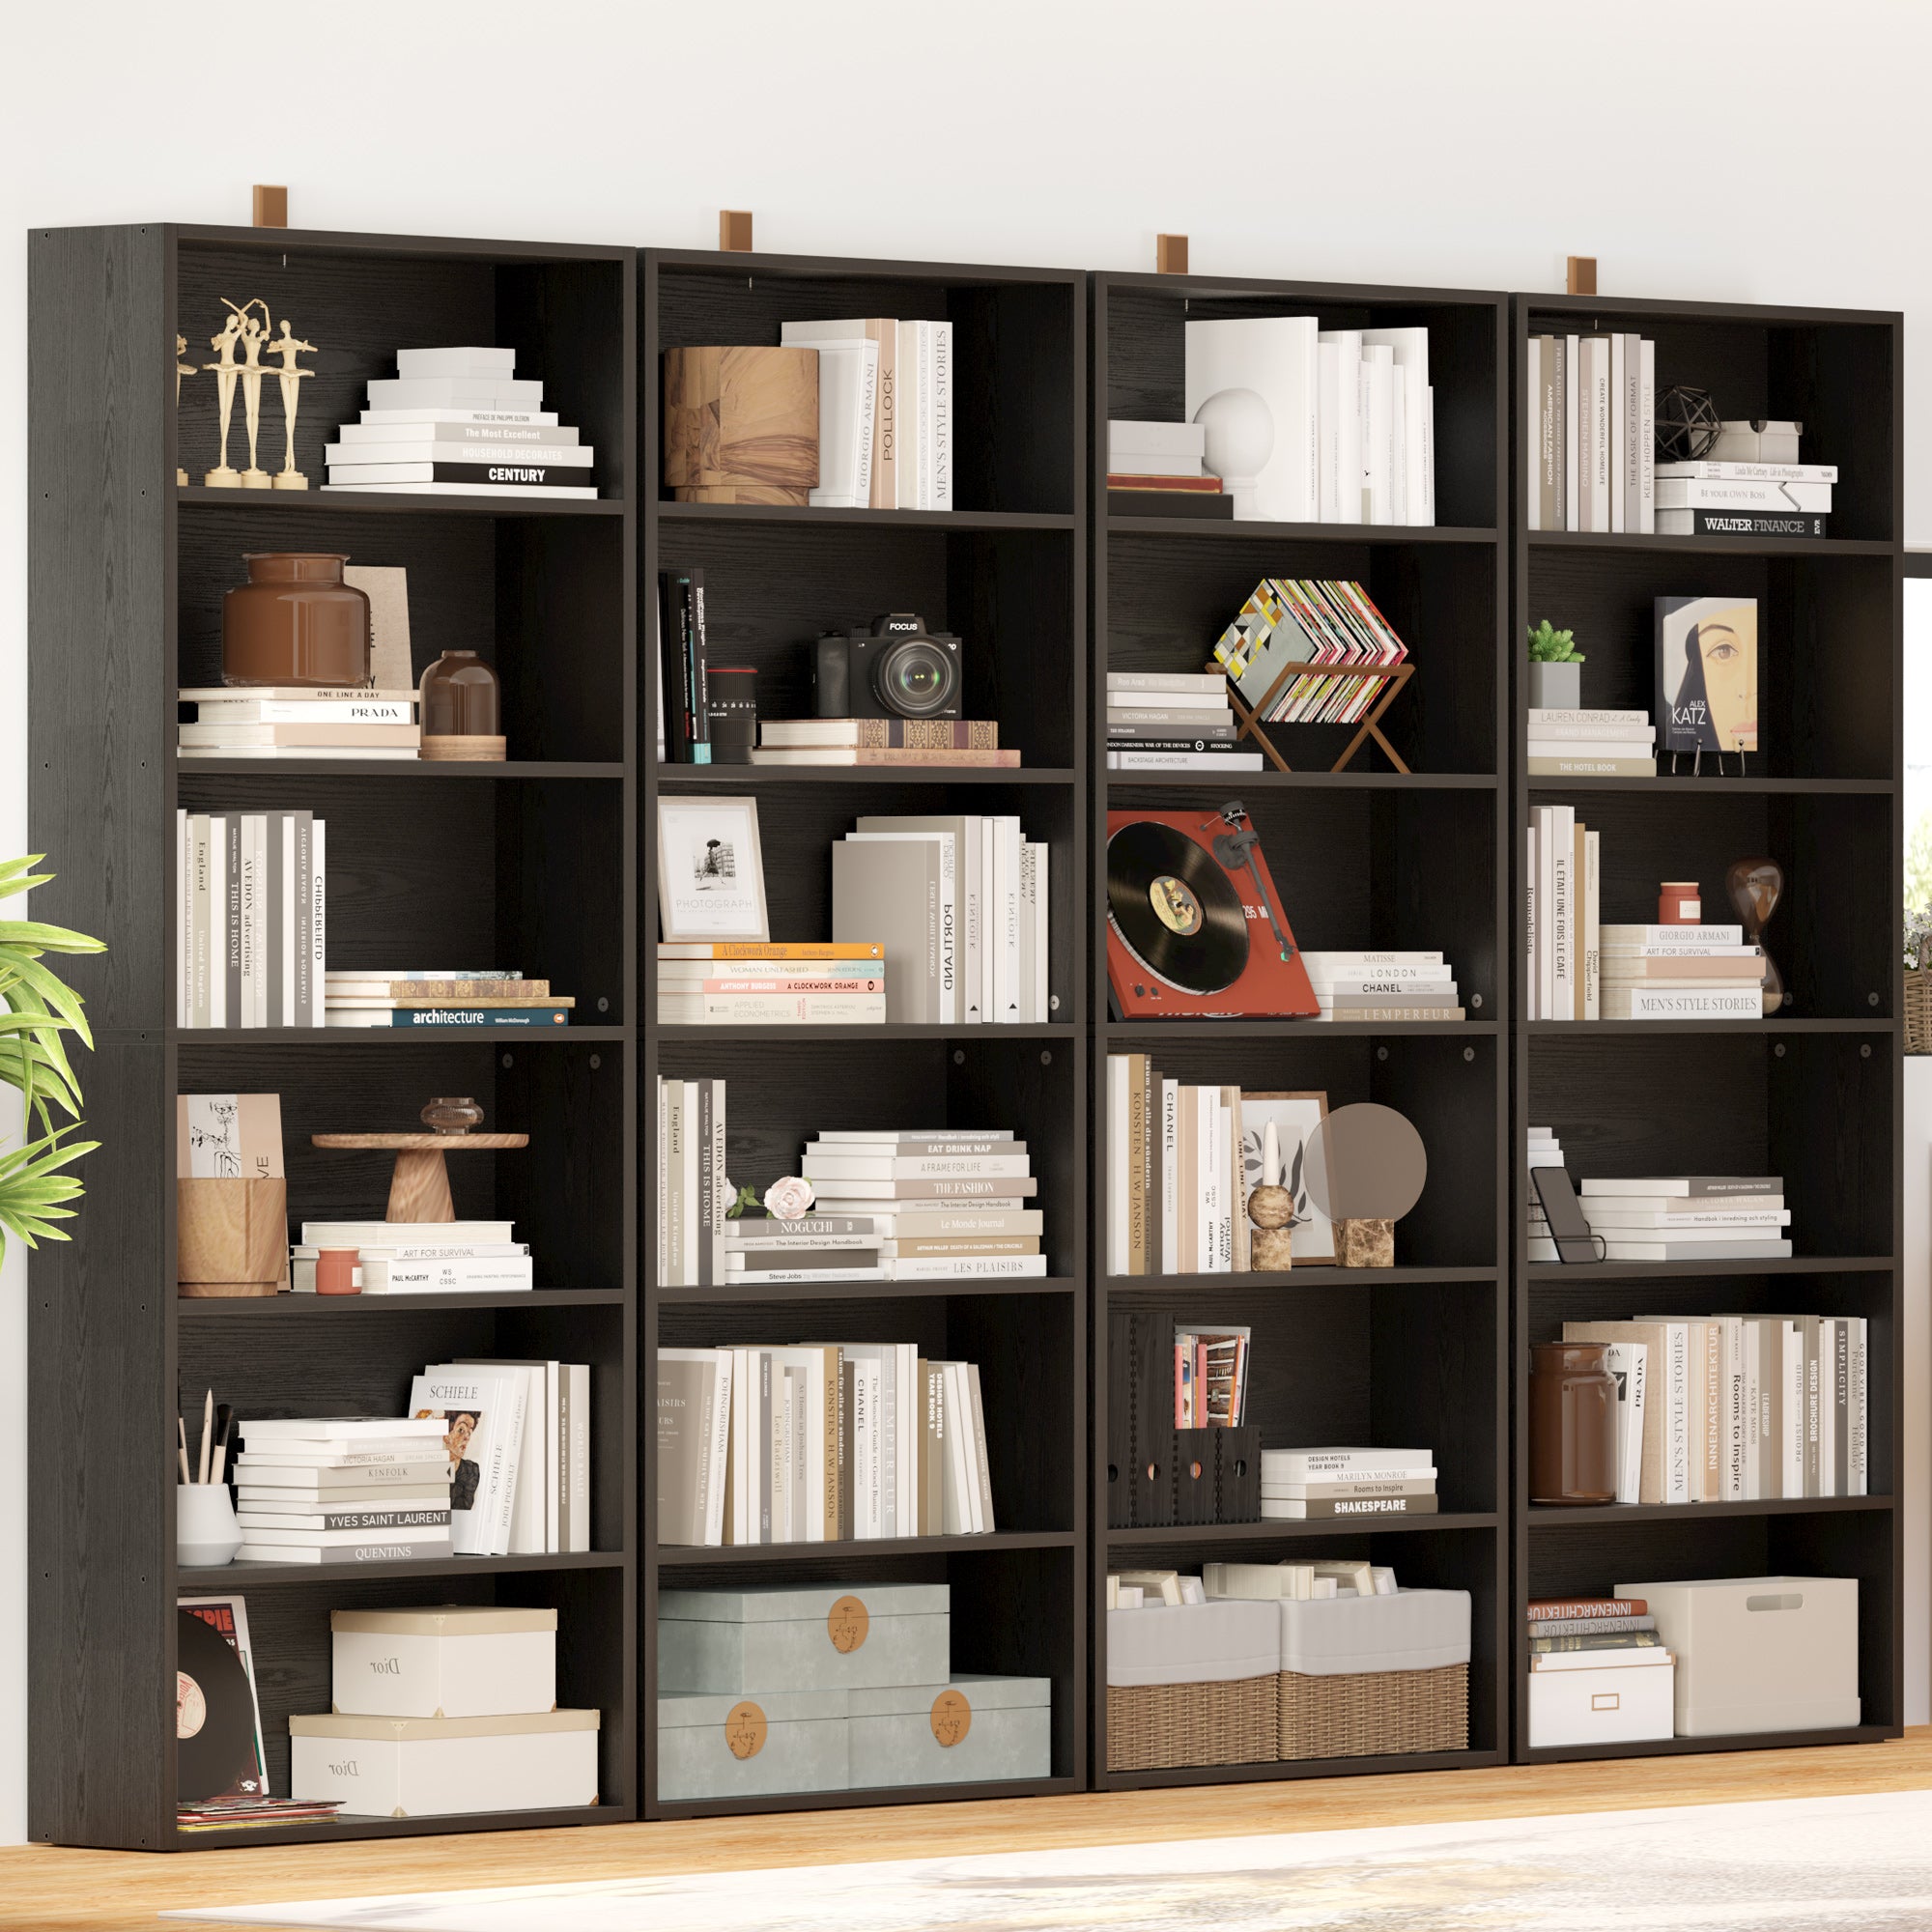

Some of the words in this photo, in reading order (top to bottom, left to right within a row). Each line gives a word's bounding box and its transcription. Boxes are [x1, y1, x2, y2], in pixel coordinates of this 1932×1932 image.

[936, 329, 947, 395] STORIES
[863, 362, 874, 421] ARMANI
[882, 368, 893, 461] POLLOCK
[936, 400, 947, 448] STYLE
[1630, 421, 1637, 434] OF
[465, 428, 479, 438] The
[481, 429, 501, 439] Most
[503, 429, 541, 440] Excellent
[463, 447, 513, 460] HOUSEHOLD
[515, 449, 563, 462] DECORATES
[859, 425, 870, 488] GIORGIO
[488, 468, 546, 482] CENTURY
[936, 452, 947, 500] MEN'S
[1704, 517, 1753, 531] WALTER
[1753, 519, 1805, 533] FINANCE
[889, 622, 919, 631] FOCUS
[351, 708, 399, 718] PRADA
[1541, 711, 1575, 723] LAUREN
[1576, 712, 1610, 724] CONRAD
[1671, 707, 1706, 725] KATZ
[1559, 762, 1573, 771] THE
[1574, 763, 1595, 772] HOTEL
[1596, 763, 1616, 772] BOOK
[197, 841, 207, 892] England
[1556, 860, 1565, 868] IL
[244, 858, 253, 910] AVEDON
[1556, 870, 1567, 895] ÉTAIT
[231, 882, 240, 911] THIS
[676, 898, 753, 910] PHOTOGRAPH
[1556, 898, 1565, 918] UNE
[231, 914, 240, 925] IS
[1556, 920, 1565, 940] FOIS
[1659, 931, 1695, 942] GIORGIO
[1696, 931, 1730, 941] ARMANI
[231, 928, 240, 967] HOME
[243, 914, 253, 977] advertising
[1556, 942, 1565, 953] LE
[1678, 948, 1712, 956] SURVIVAL
[1363, 954, 1396, 963] MATISSE
[1370, 968, 1417, 978] LONDON
[1556, 955, 1567, 980] CAFÉ
[720, 981, 750, 990] ANTHONY
[751, 981, 777, 990] BURGESS
[786, 981, 792, 990] A
[794, 981, 833, 990] CLOCKWORK
[834, 981, 859, 990] ORANGE
[1362, 983, 1403, 993] CHANEL
[733, 1000, 764, 1009] APPLIED
[1640, 997, 1674, 1011] MEN'S
[1675, 997, 1711, 1011] STYLE
[1712, 997, 1757, 1010] STORIES
[412, 1009, 485, 1025] architecture
[733, 1009, 790, 1018] ECONOMETRICS
[1363, 1009, 1451, 1021] LEMPEREUR
[671, 1106, 680, 1154] England
[927, 1145, 944, 1154] EAT
[946, 1145, 972, 1153] DRINK
[974, 1144, 992, 1152] NAP
[921, 1163, 926, 1173] A
[927, 1163, 952, 1173] FRAME
[952, 1162, 966, 1172] FOR
[967, 1162, 981, 1172] LIFE
[703, 1176, 711, 1187] IS
[933, 1182, 954, 1195] THE
[955, 1181, 995, 1194] FASHION
[715, 1175, 724, 1236] advertising
[781, 1221, 834, 1234] NOGUCHI
[941, 1219, 950, 1229] Le
[952, 1219, 977, 1229] Monde
[978, 1218, 1005, 1229] Journal
[420, 1249, 437, 1258] FOR
[439, 1248, 474, 1257] SURVIVAL
[953, 1262, 972, 1273] LES
[977, 1262, 1024, 1273] PLAISIRS
[439, 1277, 457, 1286] CSSC
[1674, 1331, 1684, 1394] STORIES
[1634, 1357, 1644, 1408] PRADA
[1809, 1359, 1818, 1392] DESIGN
[1851, 1350, 1860, 1400] Purienne
[429, 1384, 479, 1400] SCHIELE
[1708, 1326, 1718, 1470] INNENARCHITEKTUR
[1733, 1374, 1742, 1422] Rooms
[1674, 1397, 1684, 1443] STYLE
[1761, 1393, 1770, 1437] LEADERSHIP
[1809, 1394, 1818, 1442] BROCHURE
[1733, 1425, 1742, 1439] to
[885, 1388, 895, 1515] LEMPEREUR
[1850, 1427, 1860, 1470] Holiday
[342, 1456, 372, 1464] VICTORIA
[373, 1454, 395, 1463] HAGAN
[1336, 1472, 1373, 1482] MARILYN
[1374, 1470, 1407, 1480] MONROE
[1674, 1447, 1684, 1492] MEN'S
[1731, 1444, 1742, 1492] Inspire
[1353, 1485, 1375, 1493] Rooms
[1383, 1483, 1404, 1493] Inspire
[1334, 1499, 1406, 1515] SHAKESPEARE
[329, 1516, 358, 1528] YVES
[362, 1514, 394, 1526] SAINT
[397, 1512, 448, 1525] LAURENT
[355, 1546, 412, 1561] QUENTINS
[1545, 1619, 1639, 1635] INNENARCHITEKTUR
